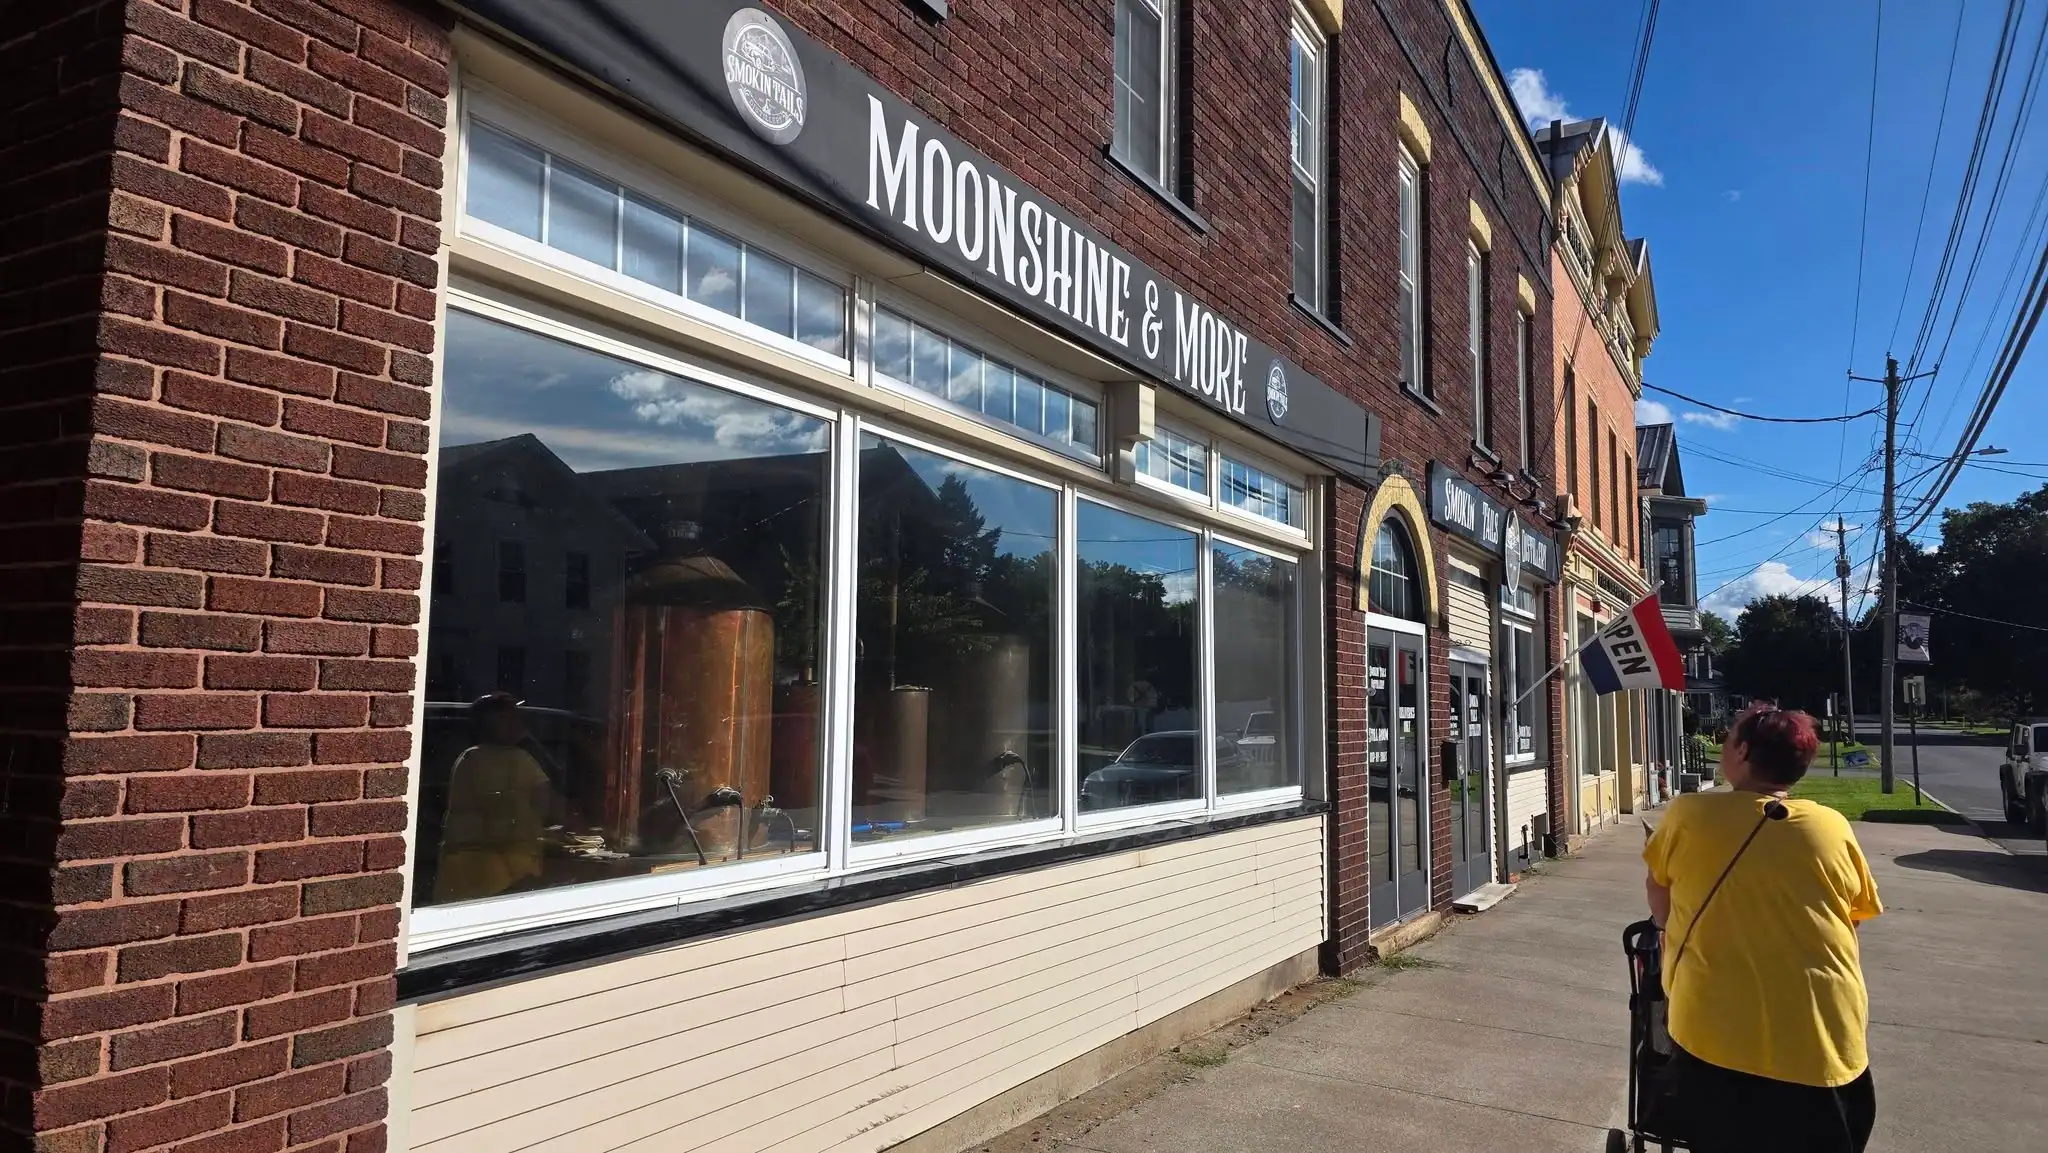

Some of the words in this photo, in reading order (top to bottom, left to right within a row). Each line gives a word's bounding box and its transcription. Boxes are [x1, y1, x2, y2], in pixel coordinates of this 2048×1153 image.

[727, 54, 772, 98] SMOKIN
[772, 79, 804, 126] TAILS
[866, 93, 1131, 348] MOONSHINE
[1141, 279, 1163, 360] &
[1174, 291, 1248, 415] MORE
[1444, 478, 1476, 532] SMOKIN
[1482, 501, 1499, 545] TAILS
